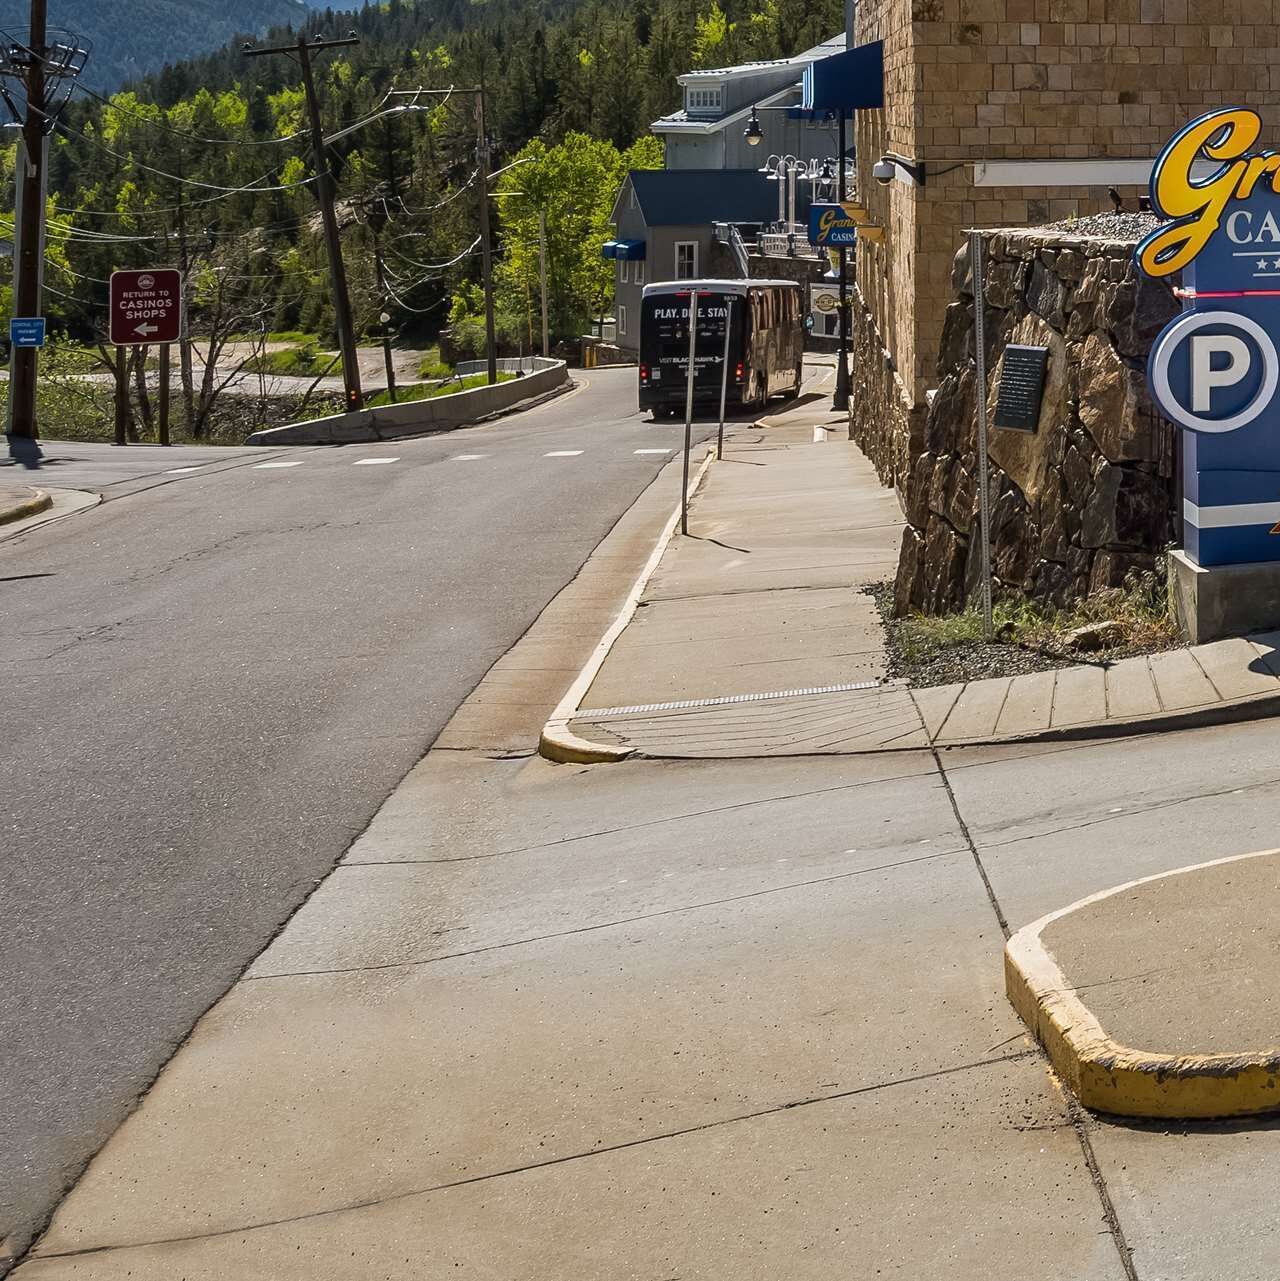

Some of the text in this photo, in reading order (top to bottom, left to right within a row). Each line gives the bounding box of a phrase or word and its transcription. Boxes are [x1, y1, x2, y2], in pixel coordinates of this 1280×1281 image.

[120, 299, 173, 309] CASINOS
[126, 309, 167, 319] SHOPS
[654, 308, 680, 319] PLAY.
[1190, 335, 1251, 412] P
